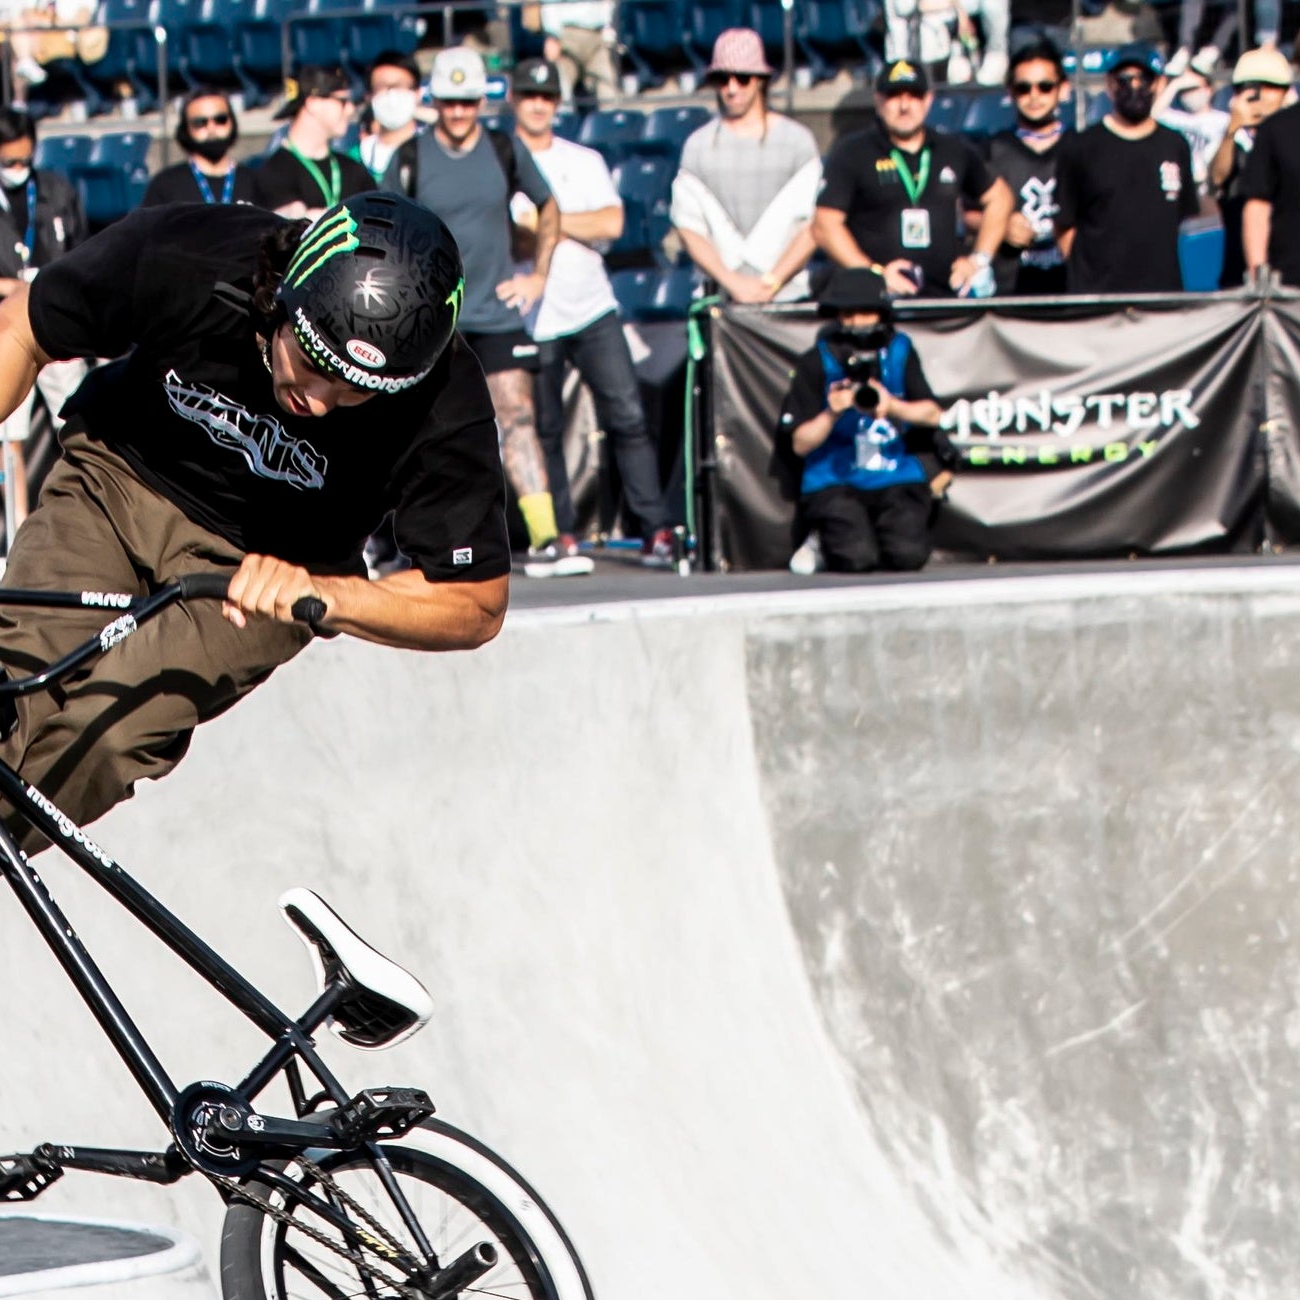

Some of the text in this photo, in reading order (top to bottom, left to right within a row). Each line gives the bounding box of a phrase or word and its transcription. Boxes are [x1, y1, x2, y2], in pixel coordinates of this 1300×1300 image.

[353, 345, 378, 364] BELL
[968, 439, 1158, 466] ENERGY
[26, 785, 115, 868] mongoose
